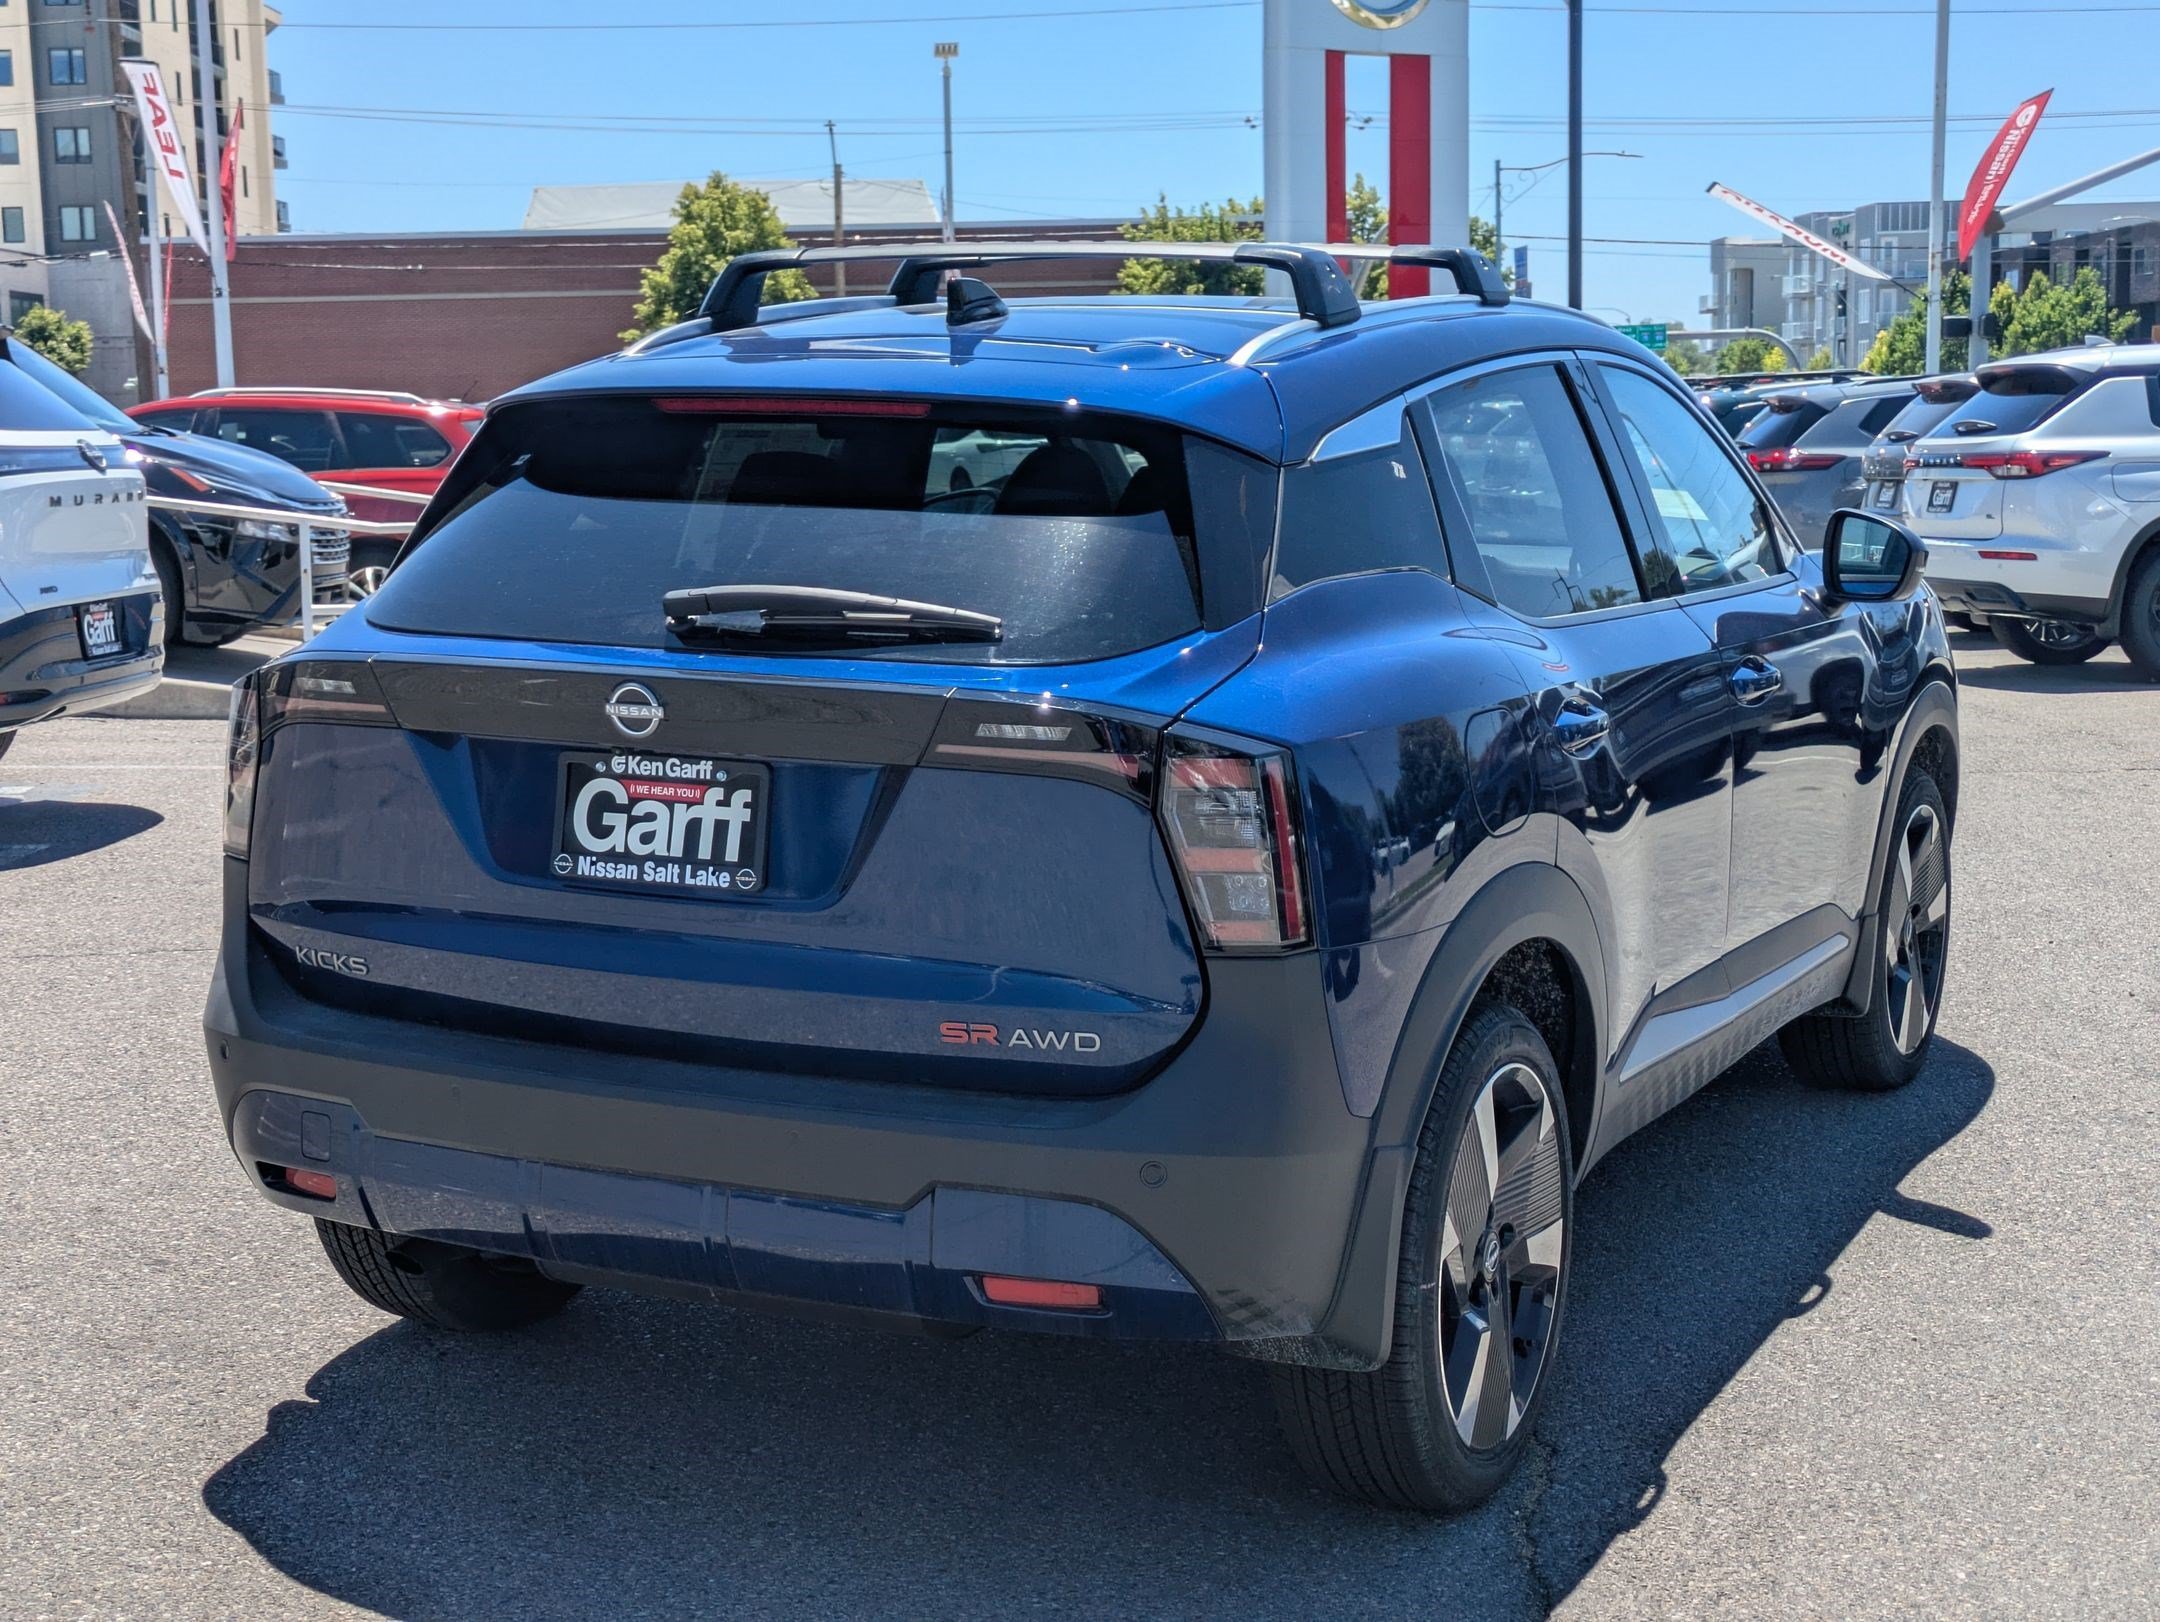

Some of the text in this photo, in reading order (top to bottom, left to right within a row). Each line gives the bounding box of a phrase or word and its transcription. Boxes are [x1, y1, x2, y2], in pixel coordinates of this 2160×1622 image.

[84, 611, 115, 645] Garff
[606, 704, 663, 718] NISSAN
[627, 755, 713, 780] Ken Garff
[636, 785, 694, 798] WE HEAR YOU
[573, 777, 752, 862] Garff
[577, 855, 731, 888] Nissan Salt Lake
[296, 946, 368, 976] KICKS
[939, 1021, 1101, 1053] SR AWD
